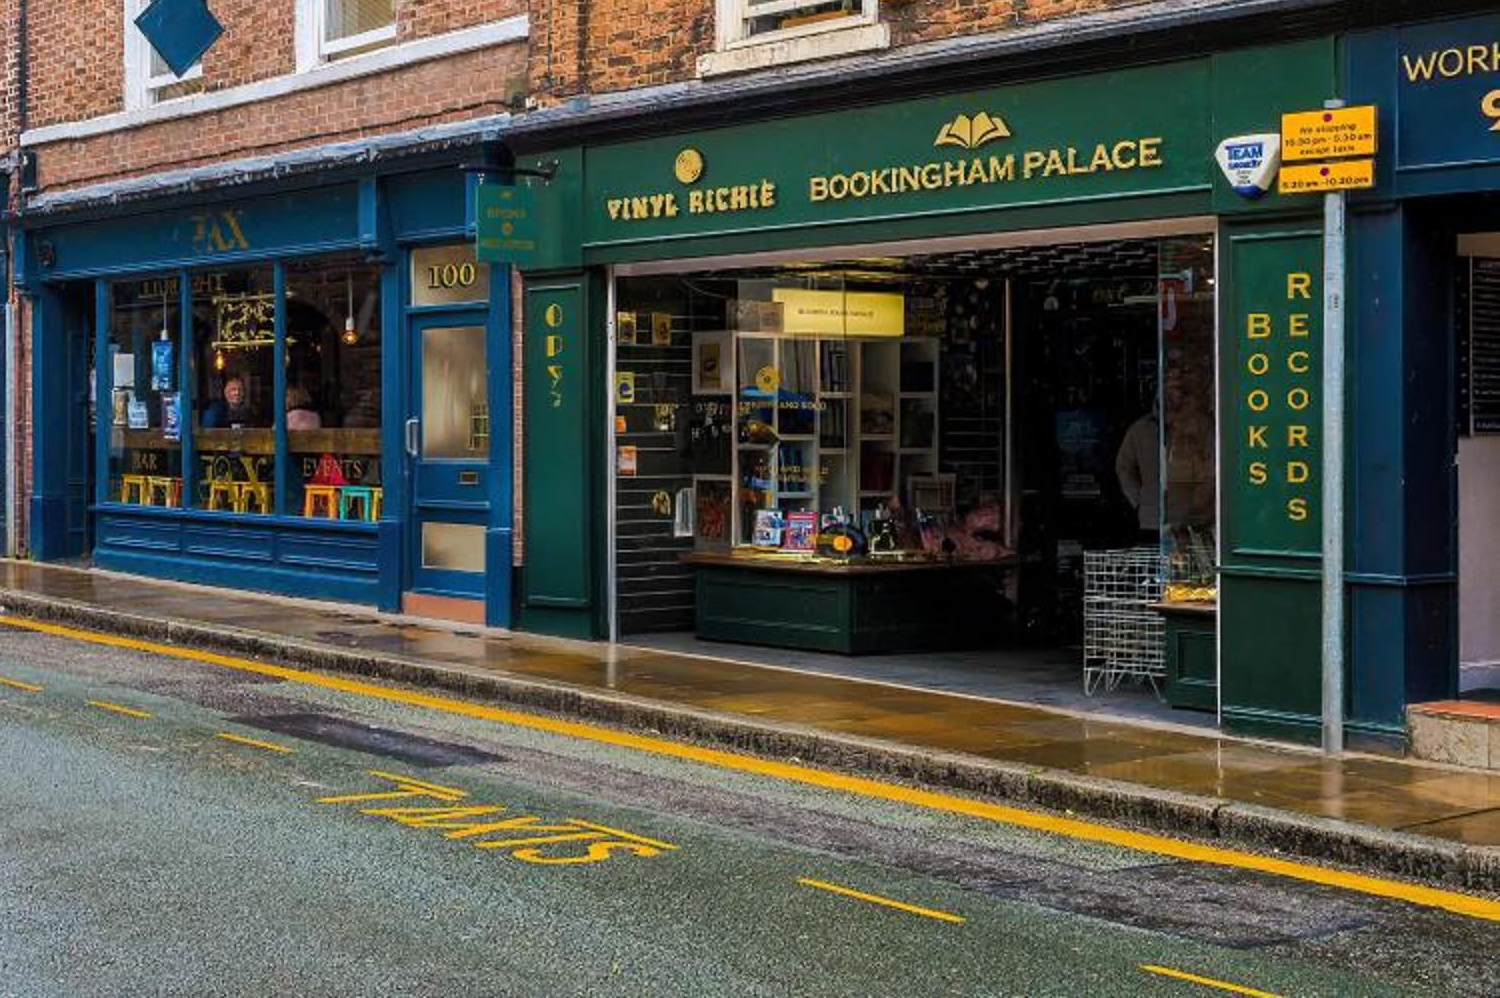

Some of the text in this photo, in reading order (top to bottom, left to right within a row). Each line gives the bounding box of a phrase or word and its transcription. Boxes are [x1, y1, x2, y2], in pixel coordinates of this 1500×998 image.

[809, 137, 1163, 201] BOOKINGHAM PALACE
[1225, 142, 1263, 160] TEAM
[607, 179, 776, 221] VINYL RICHIE
[429, 261, 476, 288] 100
[1247, 313, 1271, 485] BOOKS
[1286, 273, 1310, 521] RECORDS
[303, 455, 362, 479] EVENTS
